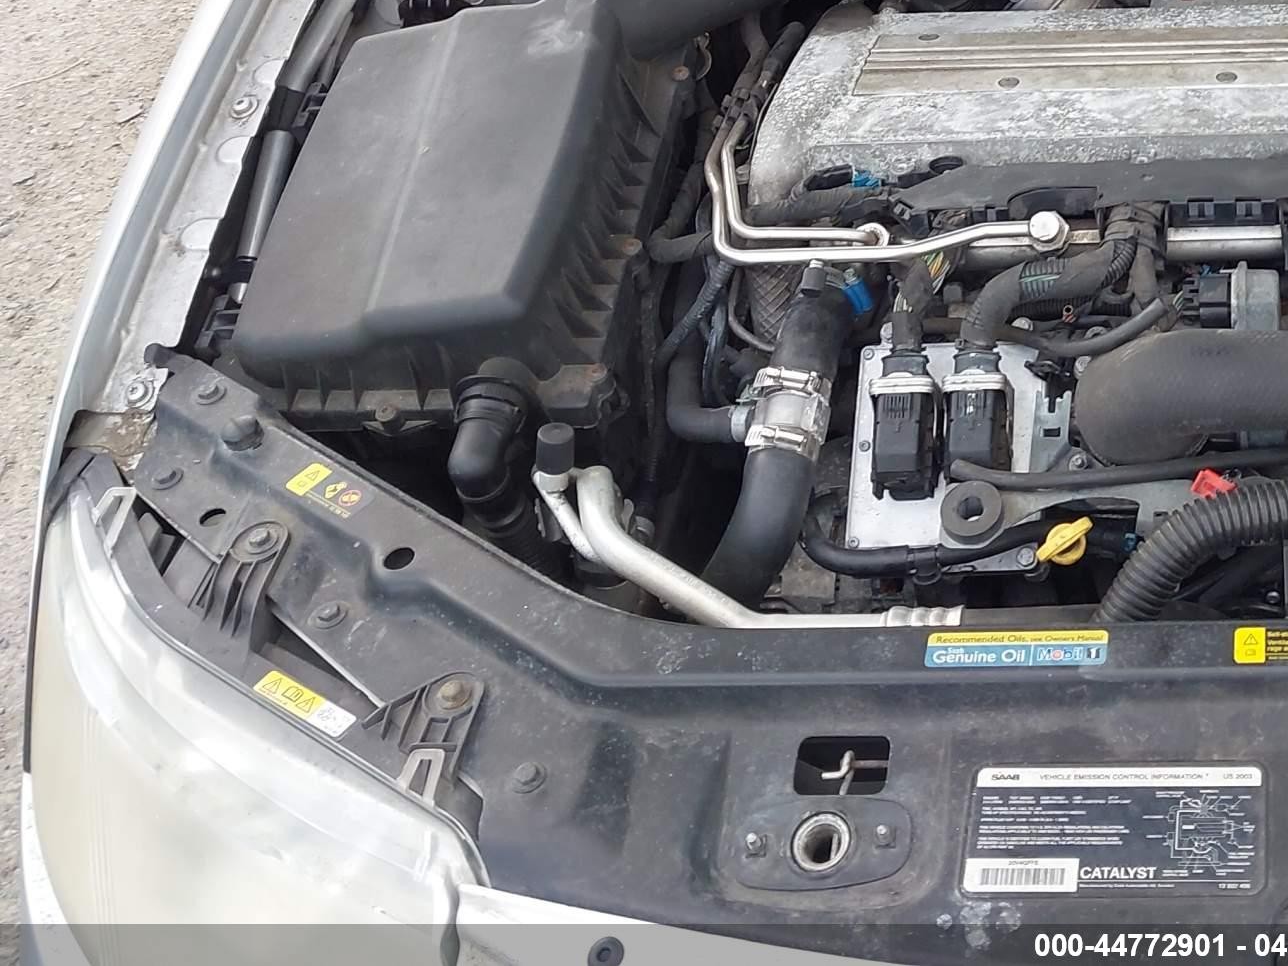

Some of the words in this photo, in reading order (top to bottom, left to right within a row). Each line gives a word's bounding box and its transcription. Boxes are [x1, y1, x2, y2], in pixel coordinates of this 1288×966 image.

[936, 634, 1004, 643] Recommended
[932, 650, 997, 663] Genuine
[1001, 649, 1025, 663] Oil
[1036, 647, 1083, 661] Mobil
[991, 773, 1021, 782] SAAB
[1040, 773, 1071, 781] VEHICLE
[1074, 773, 1110, 781] EMISSION
[1112, 773, 1149, 781] CONTROL
[1151, 773, 1204, 781] INFORMATION
[1080, 866, 1157, 879] CATALYST
